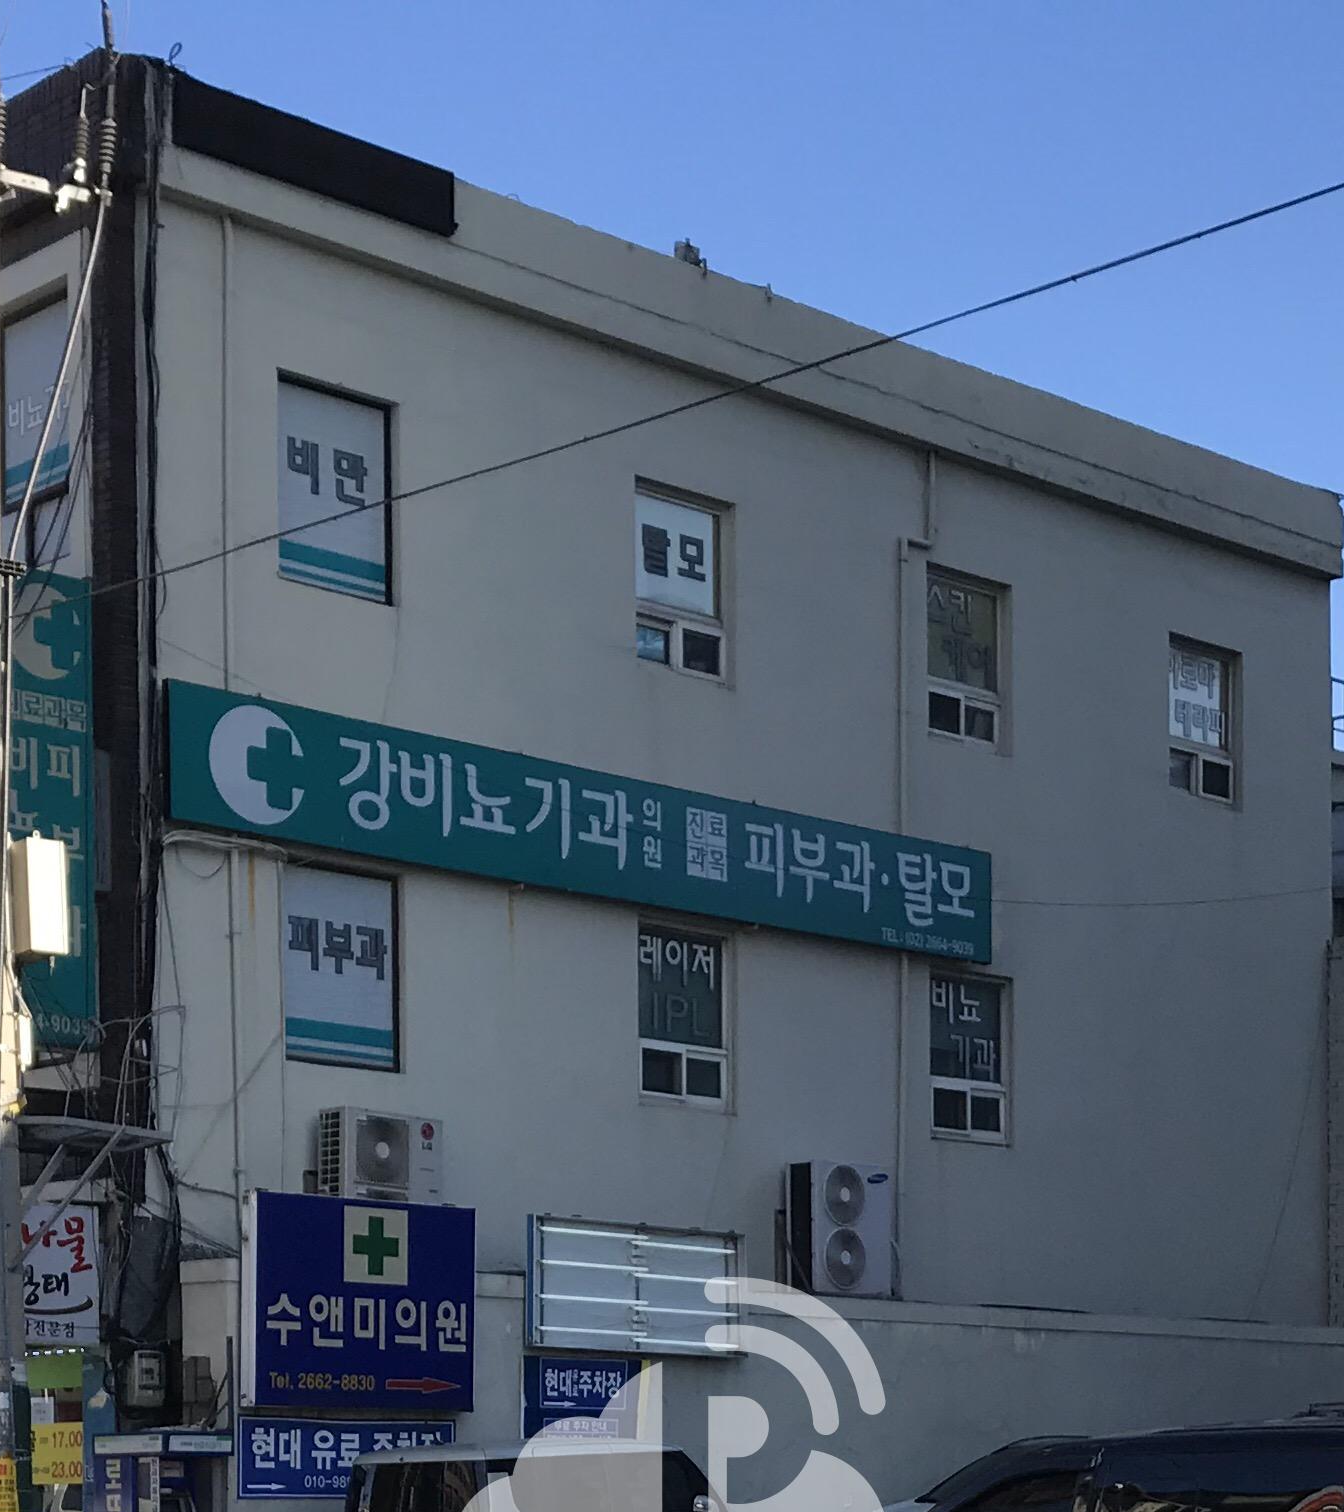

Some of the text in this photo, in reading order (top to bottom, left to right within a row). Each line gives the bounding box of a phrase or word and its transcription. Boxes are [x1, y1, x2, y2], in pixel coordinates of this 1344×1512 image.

[287, 435, 368, 508] 비만
[642, 523, 707, 583] 탈모
[11, 689, 87, 733] 료과목
[338, 735, 635, 872] 강비뇨기과
[642, 797, 663, 870] 의원
[288, 914, 388, 981] 피부과
[639, 934, 715, 991] 레이저
[932, 979, 982, 1024] 비뇨
[950, 1033, 997, 1081] 기과
[22, 1215, 93, 1274] 나물
[265, 1292, 467, 1353] 수앤미의원
[269, 1372, 376, 1391] Tel. 2662-8830
[544, 1368, 572, 1398] 현대
[579, 1370, 622, 1399] 주차장
[251, 1427, 302, 1470] 현대
[311, 1429, 360, 1471] 유료
